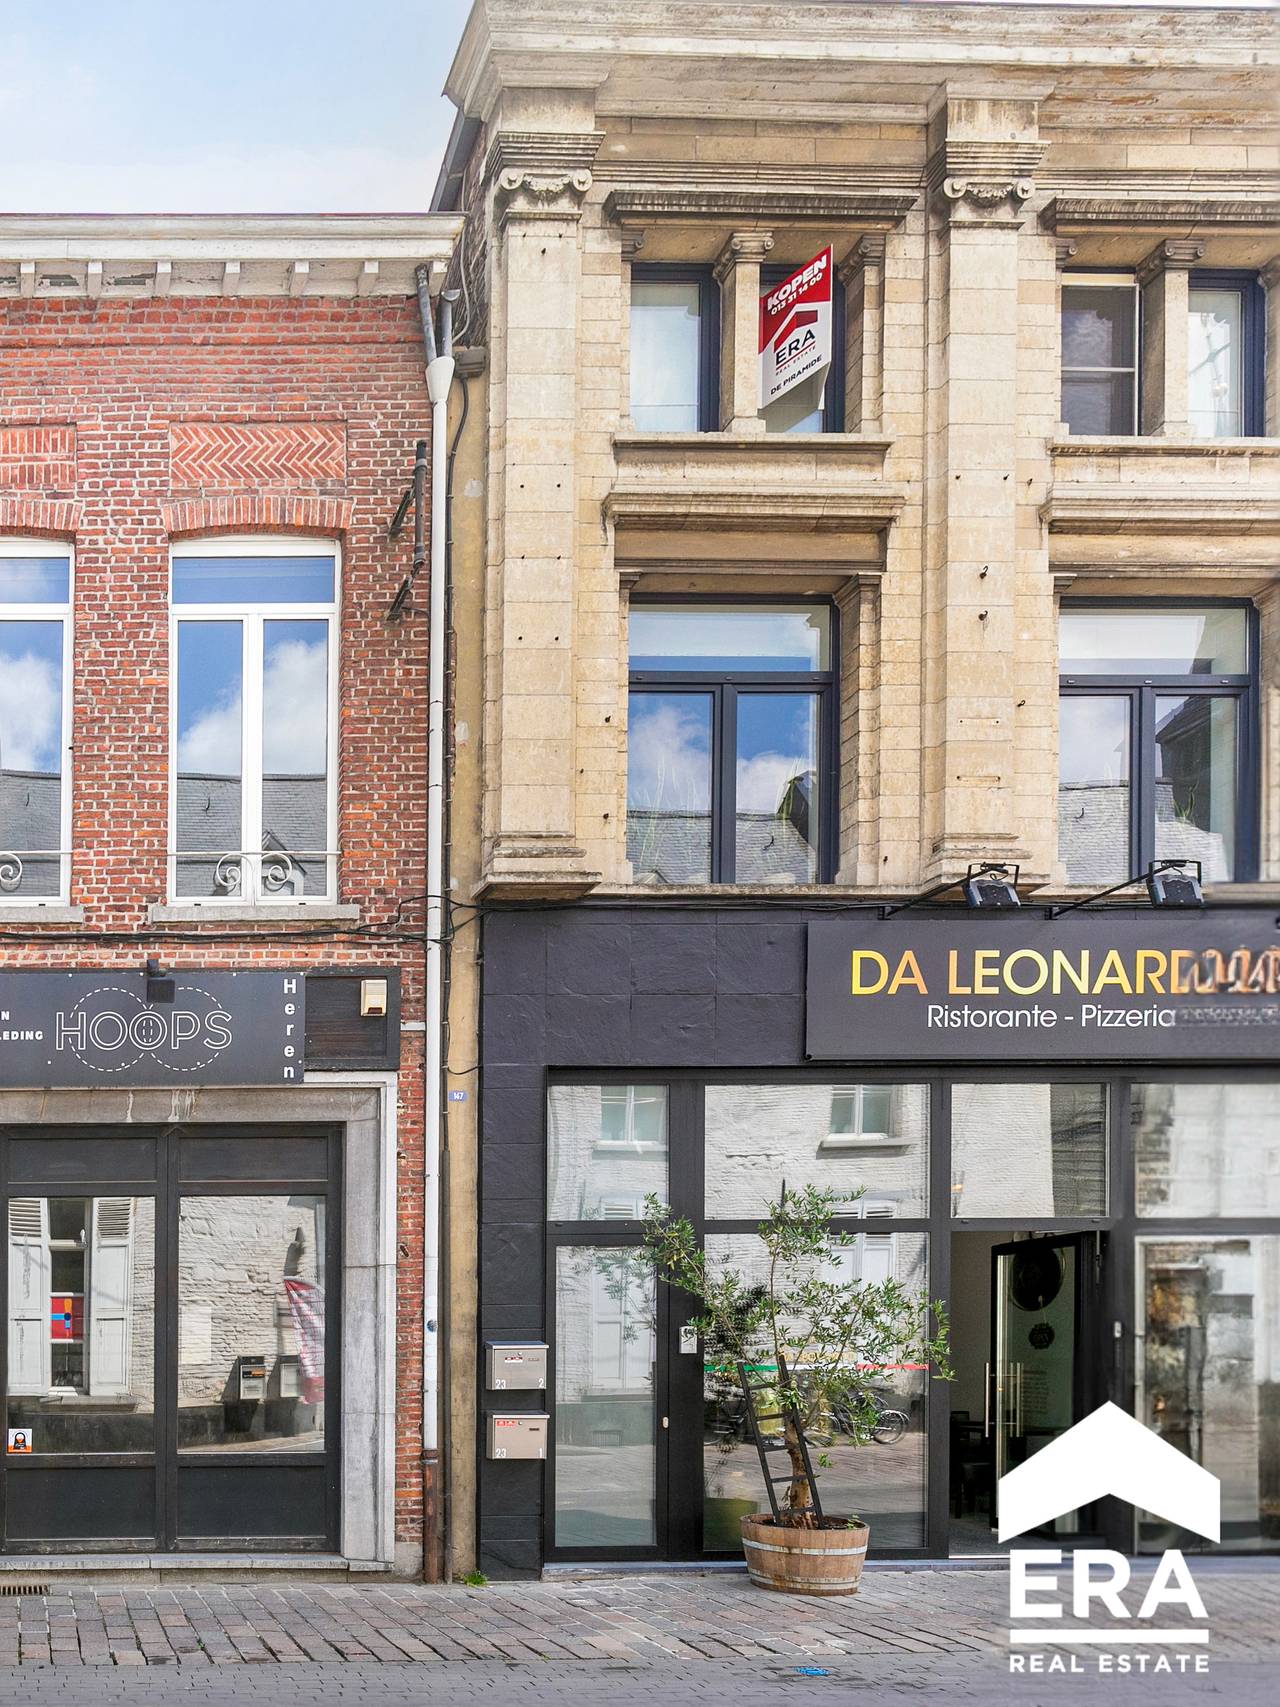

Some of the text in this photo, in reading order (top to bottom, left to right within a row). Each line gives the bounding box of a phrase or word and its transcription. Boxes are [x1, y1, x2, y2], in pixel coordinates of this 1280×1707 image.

[767, 254, 827, 311] KOPEN
[771, 272, 823, 315] 013 31 14 00
[776, 329, 815, 366] ERA
[776, 345, 816, 376] REAL ESTATE
[770, 354, 822, 395] DE PIRAMIDE
[851, 949, 928, 996] DA
[55, 1010, 233, 1051] HOOPS
[283, 978, 298, 1079] Heren
[926, 1004, 1058, 1029] Ristorante
[1081, 1004, 1177, 1028] Pizzeria
[495, 1378, 544, 1389] 23 2
[495, 1448, 507, 1458] 23
